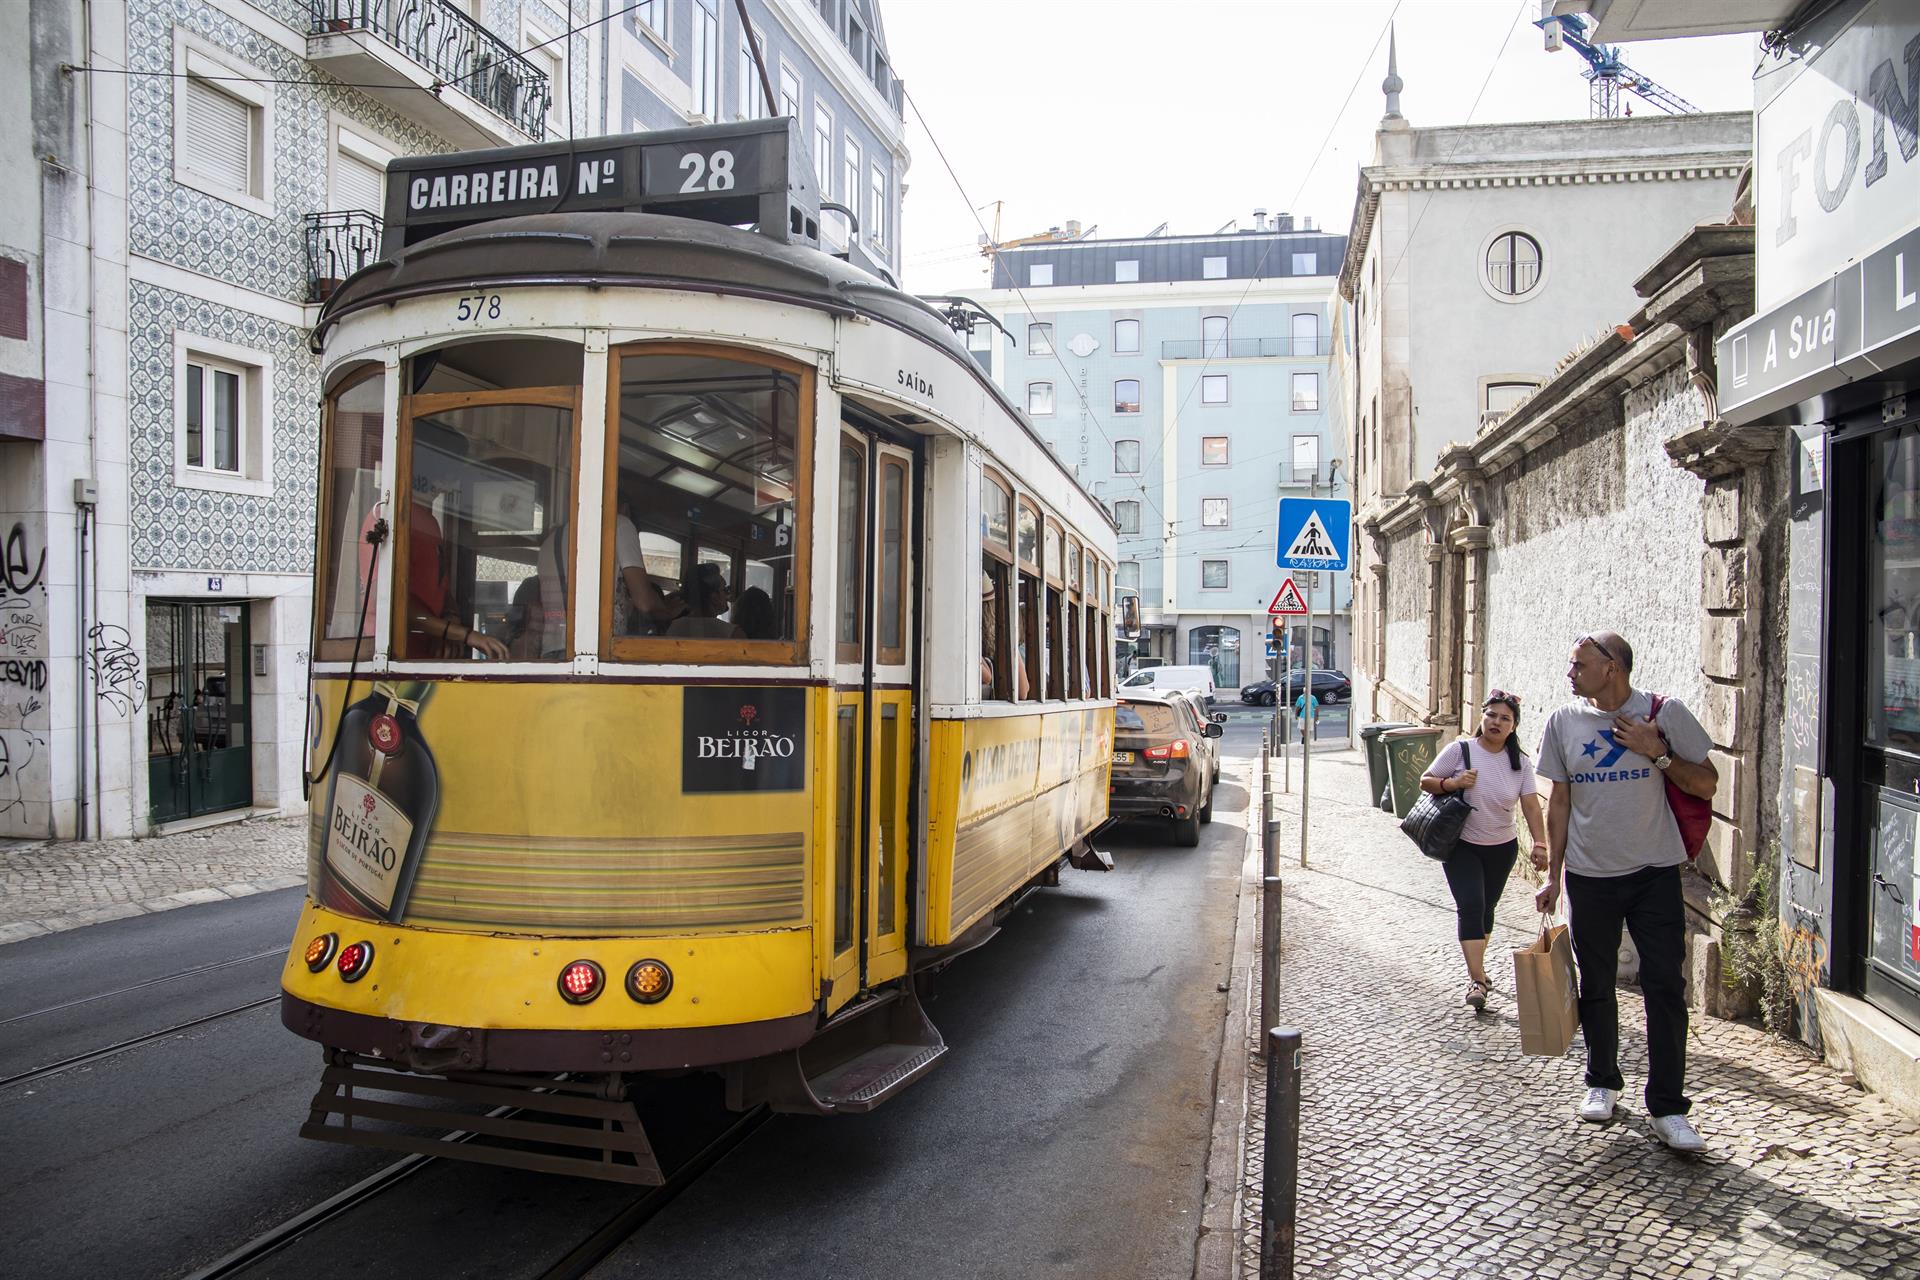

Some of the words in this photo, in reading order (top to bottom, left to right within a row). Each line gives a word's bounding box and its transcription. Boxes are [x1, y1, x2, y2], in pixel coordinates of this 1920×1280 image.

[411, 165, 559, 210] CARREIRA
[578, 159, 615, 195] Nº
[679, 150, 735, 194] 28
[457, 295, 501, 321] 578
[1763, 329, 1777, 374] A
[1788, 307, 1836, 360] Sua
[697, 734, 795, 758] BEIRÃO
[334, 804, 397, 872] BEIRÃO
[352, 810, 381, 836] LICOR
